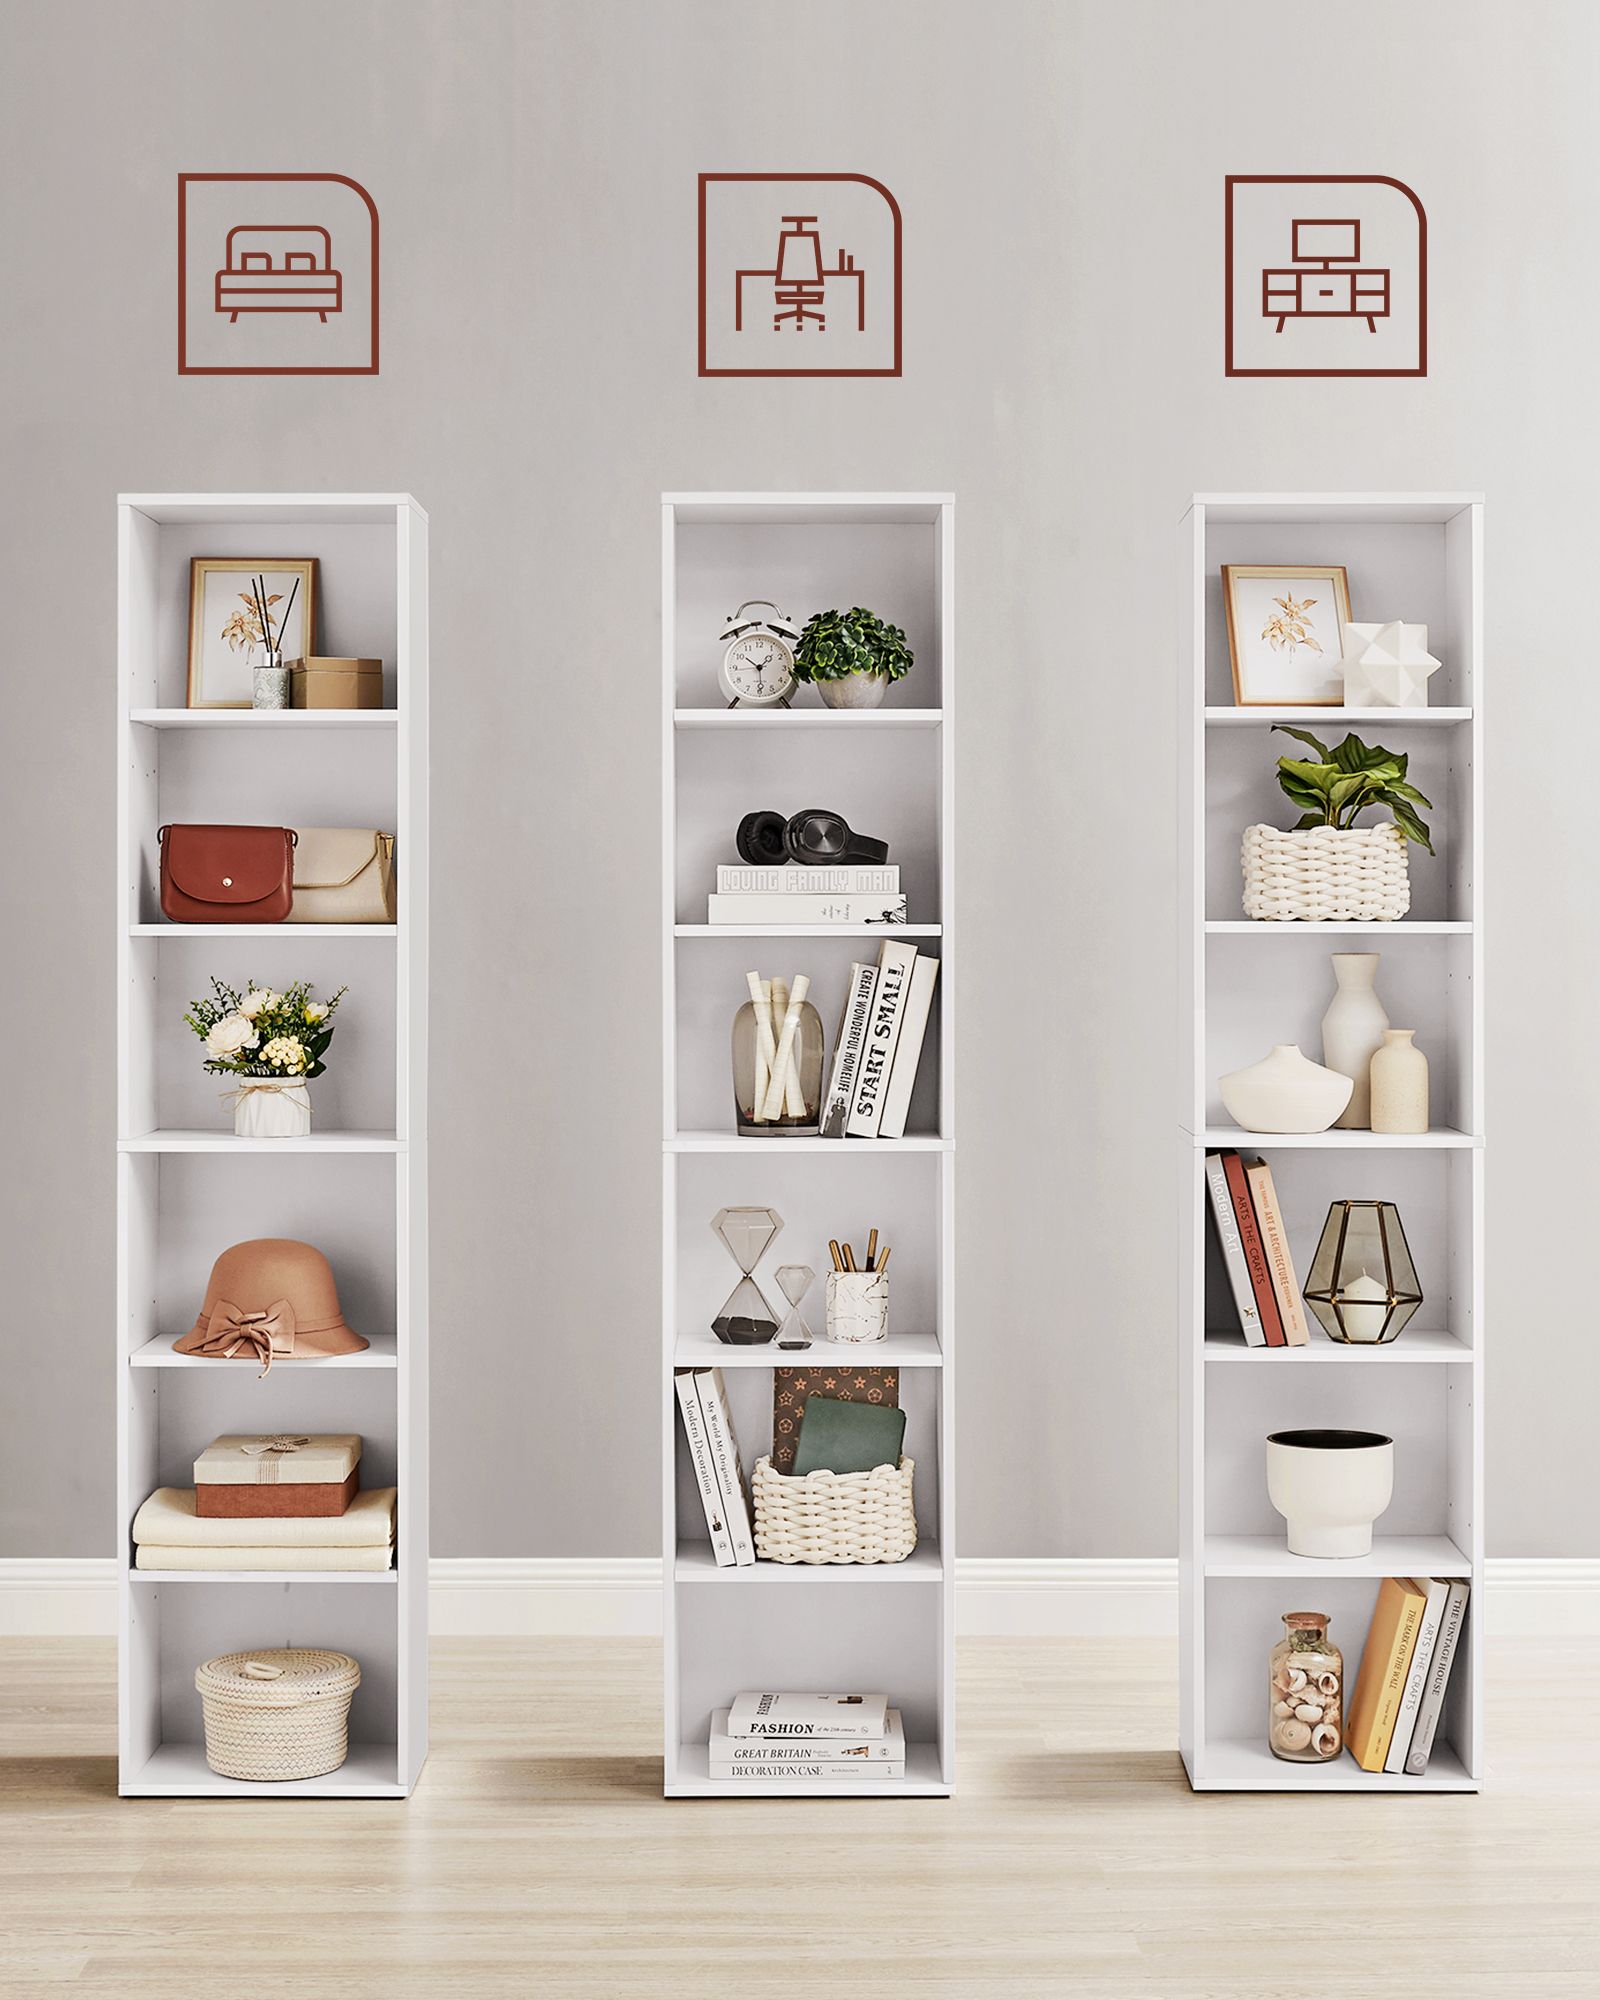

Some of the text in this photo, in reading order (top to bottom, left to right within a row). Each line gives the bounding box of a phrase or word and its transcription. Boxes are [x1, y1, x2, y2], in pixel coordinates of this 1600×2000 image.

[722, 870, 895, 892] LOVING FAMILY MAN
[837, 969, 874, 1092] CREATE WONDERFUL HOMELIFE
[856, 963, 905, 1118] START SMALL
[1211, 1173, 1241, 1253] Modern Art
[1236, 1195, 1265, 1285] ARTS THE CRAFTS
[1264, 1211, 1275, 1225] ART
[1270, 1233, 1290, 1287] ARCHITECTURE
[684, 1399, 712, 1496] Modern Decoration
[706, 1401, 733, 1496] My World My Originality
[1388, 1609, 1417, 1690] THE MARK ON THE WALL
[1406, 1622, 1435, 1711] ARTS THE CRAFTS
[1431, 1600, 1463, 1696] THE VINTAGE HOUSE
[731, 1766, 824, 1776] DECORATION CASE
[734, 1748, 769, 1759] GREAT
[770, 1748, 812, 1758] BRITAIN
[750, 1723, 815, 1734] FASHION
